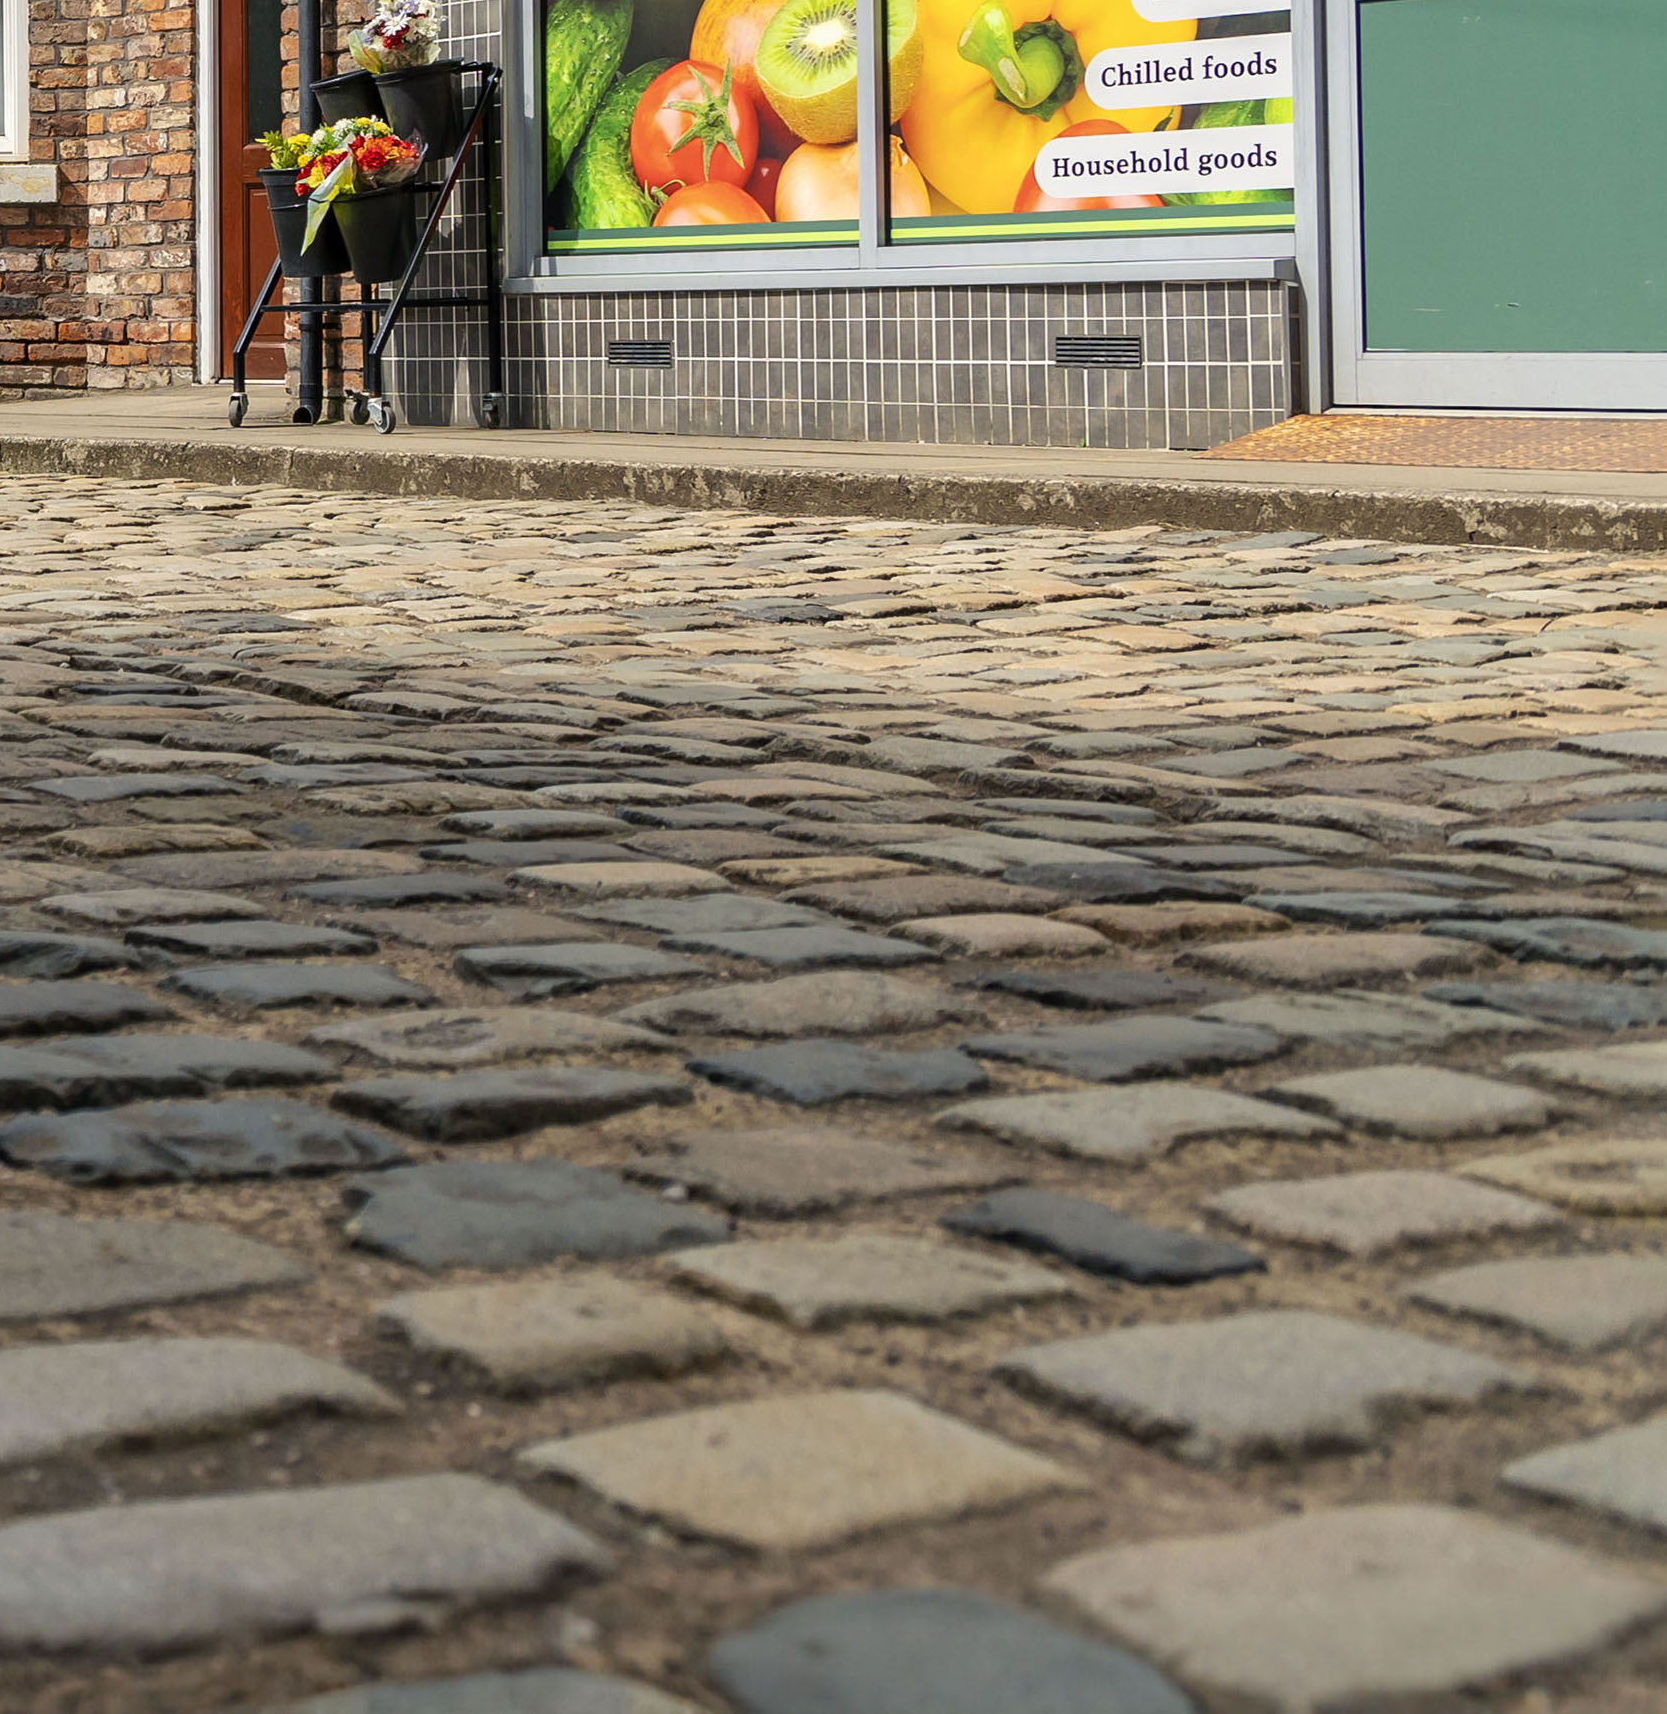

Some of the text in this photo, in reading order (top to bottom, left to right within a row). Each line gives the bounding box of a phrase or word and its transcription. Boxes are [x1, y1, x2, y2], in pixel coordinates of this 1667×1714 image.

[1100, 51, 1278, 88] Chilled foods
[1051, 143, 1278, 178] Household goods
